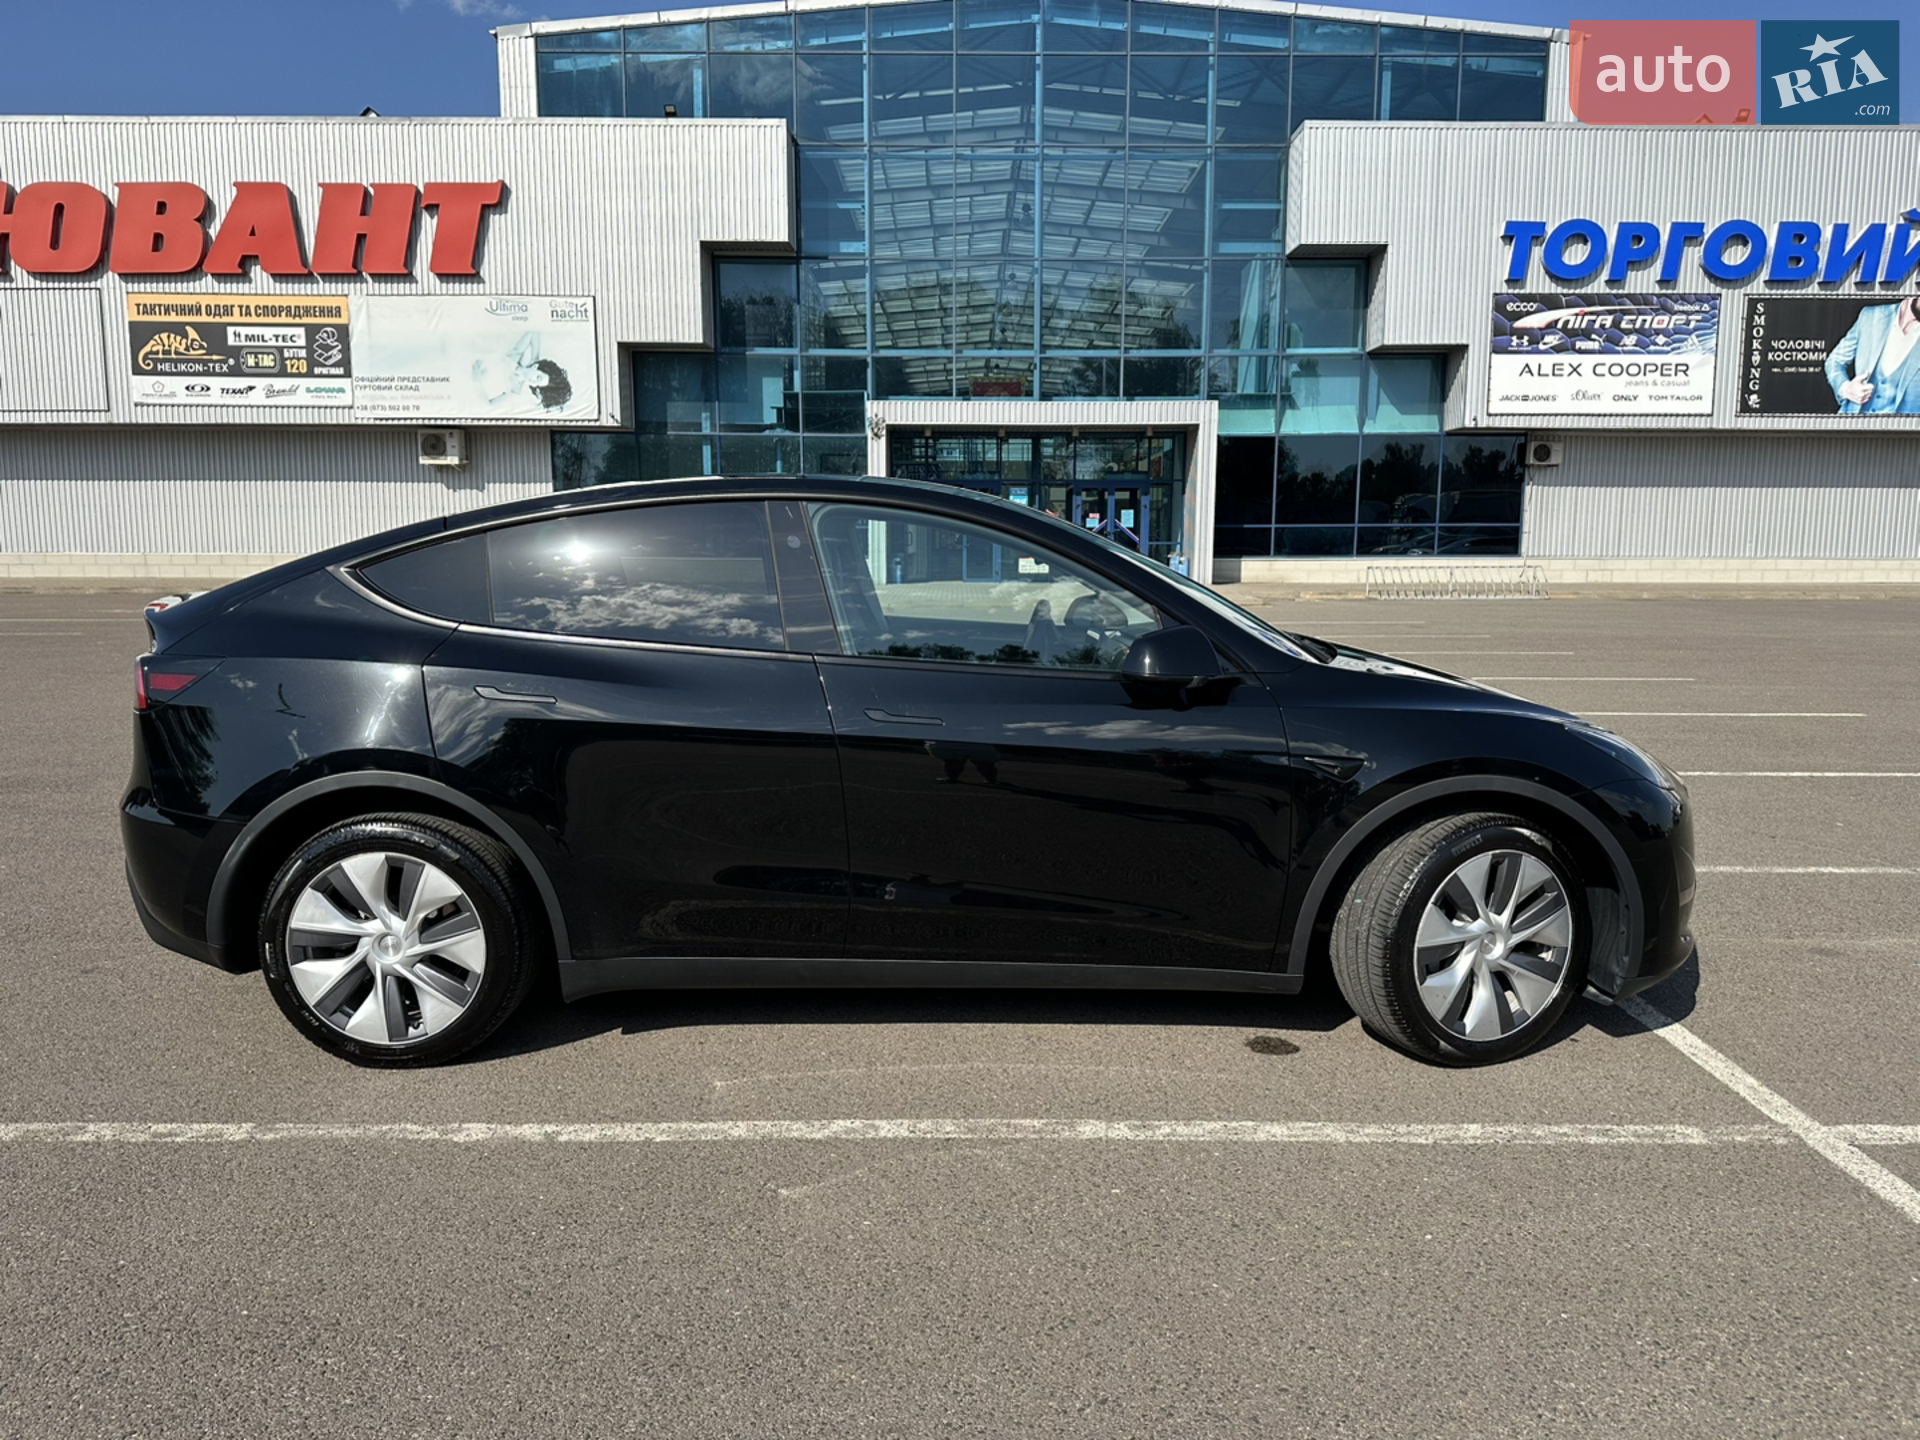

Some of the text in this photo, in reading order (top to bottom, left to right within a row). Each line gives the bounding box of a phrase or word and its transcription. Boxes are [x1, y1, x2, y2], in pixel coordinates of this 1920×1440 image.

[135, 301, 342, 320] ТАКТИЧНИЙ ОДЯГ ТА СПОРЯДЖЕННЯ
[489, 300, 529, 314] Ultima
[551, 303, 589, 319] nacht
[1506, 302, 1536, 311] ecco
[1620, 315, 1702, 329] СПОРТ
[244, 334, 298, 343] MIL-TEC
[1770, 340, 1825, 349] ЧОЛОВІЧІ
[1767, 351, 1828, 361] КОСТЮМИ
[157, 362, 229, 373] HELIKON-TEX
[285, 359, 308, 374] 120
[1518, 363, 1690, 377] ALEX COOPER
[354, 375, 451, 384] ОФІЦІЙНИЙ ПРЕДСТАВНИК
[1624, 379, 1650, 388] jeans
[1660, 379, 1691, 387] casual
[355, 384, 393, 392] ГУРТОВИЙ
[1612, 394, 1639, 402] ONLY
